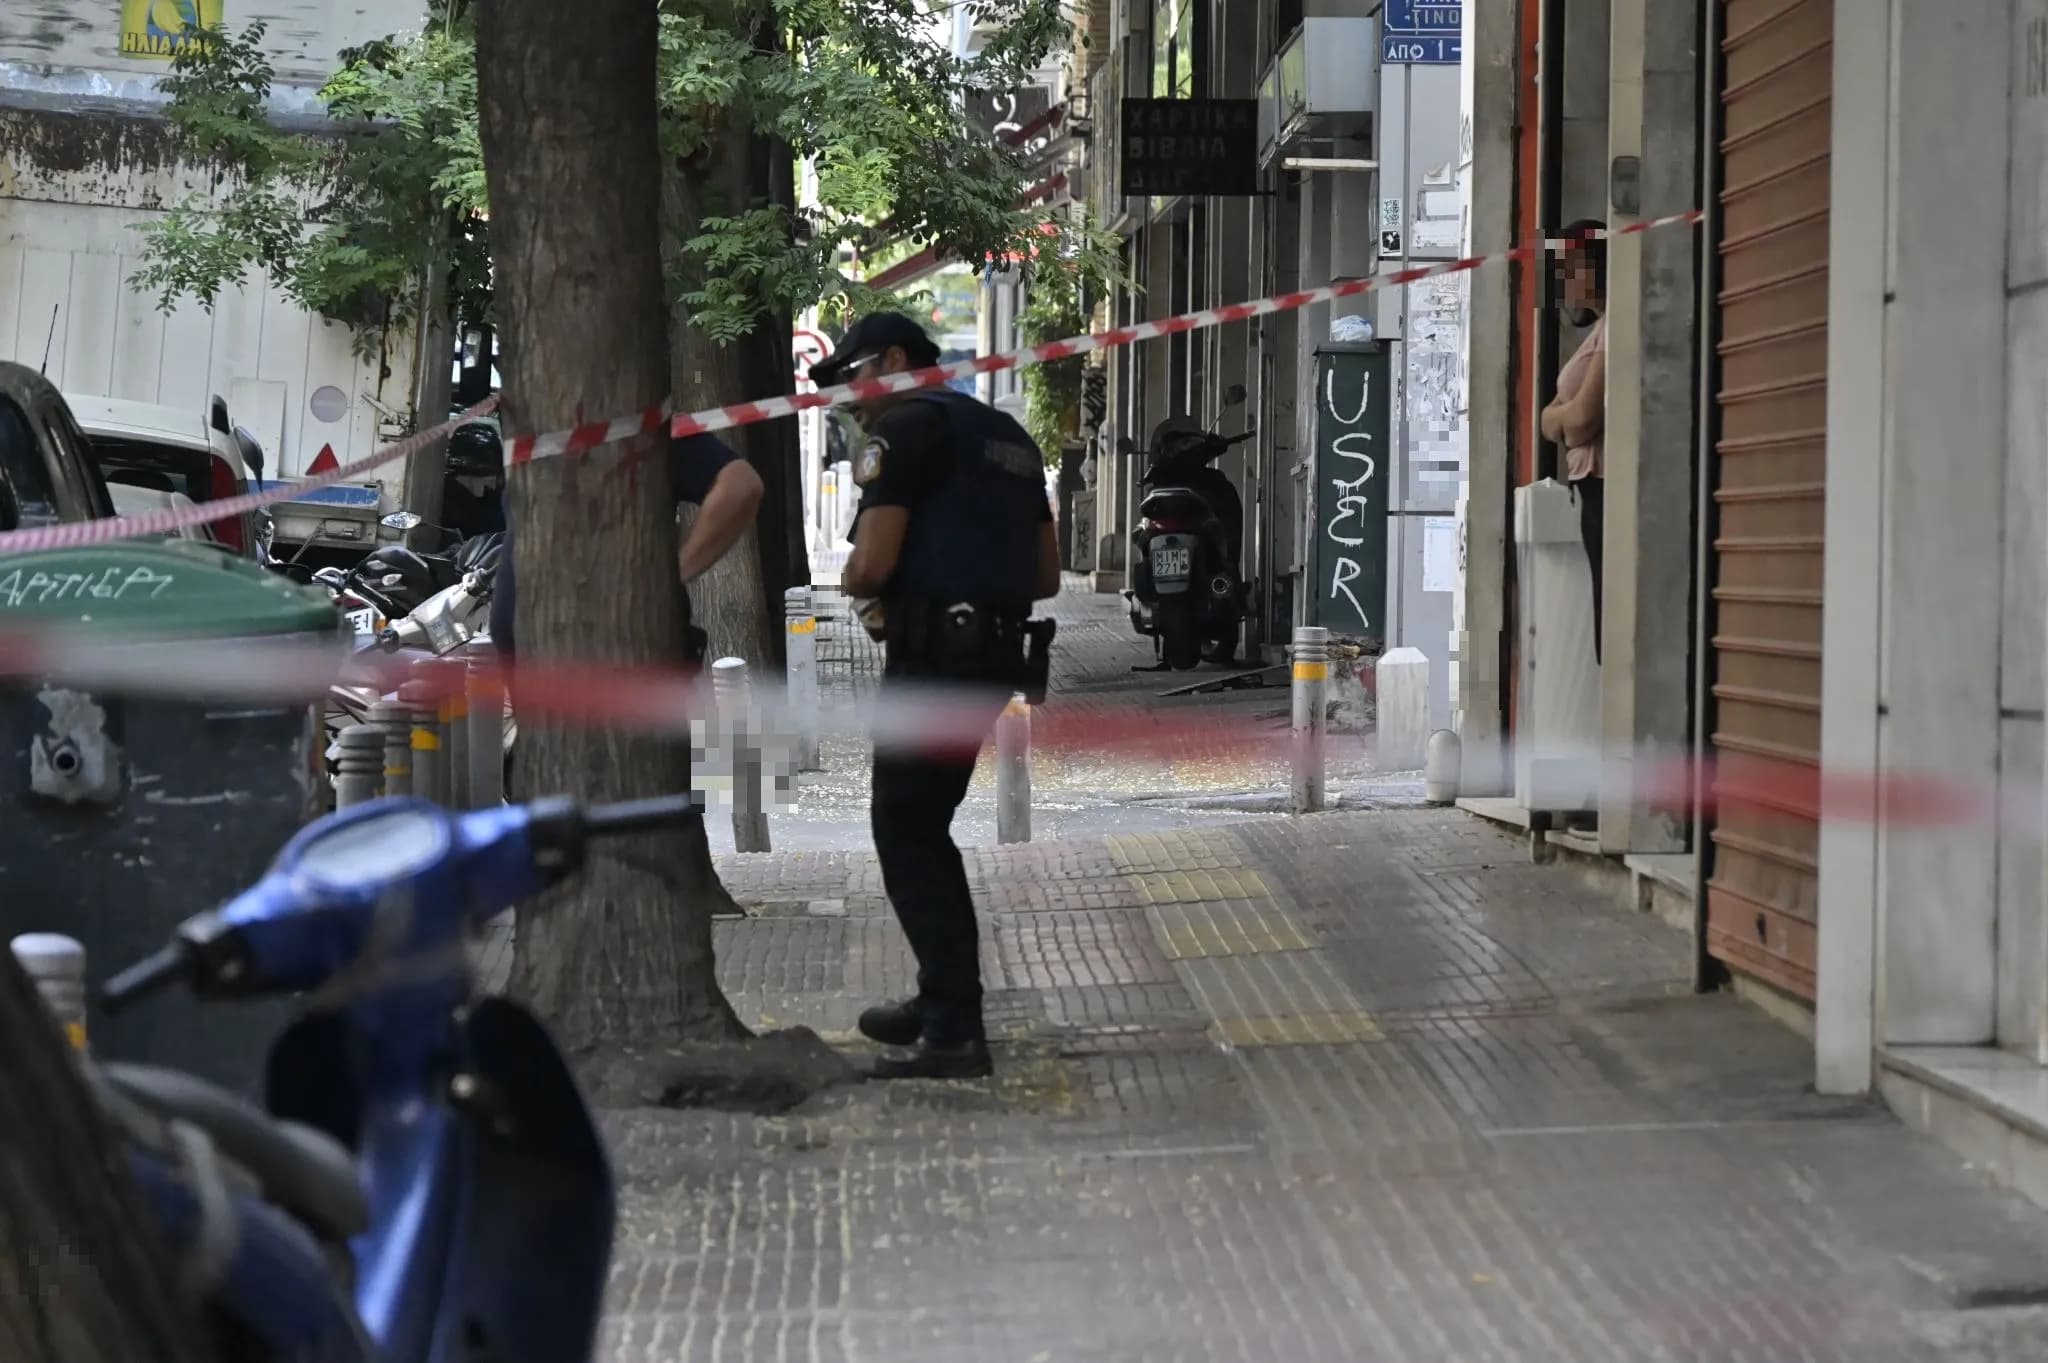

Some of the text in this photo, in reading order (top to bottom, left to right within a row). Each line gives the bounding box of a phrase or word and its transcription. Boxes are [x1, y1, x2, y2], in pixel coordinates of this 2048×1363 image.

[1128, 106, 1248, 128] ΧΑΡΤΙΚΑ
[1128, 136, 1225, 159] ΒΙΒΛΙΑ
[1327, 368, 1375, 628] USER
[1156, 562, 1177, 575] 271
